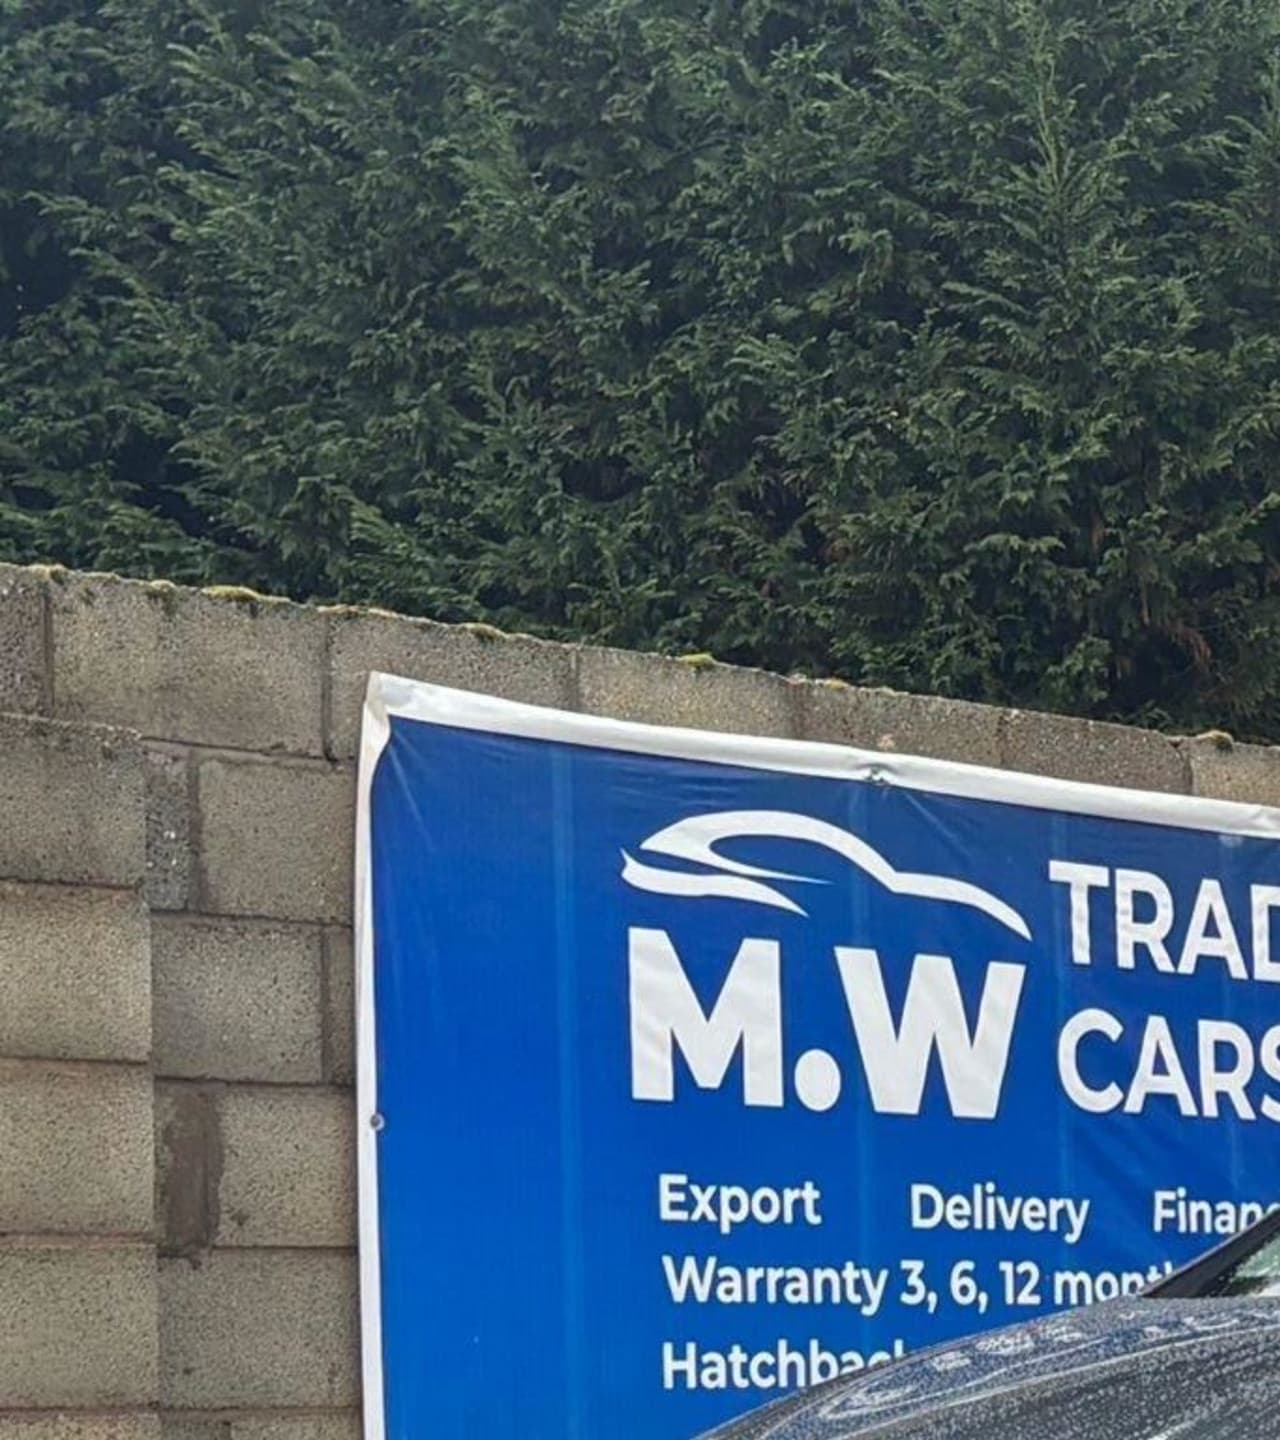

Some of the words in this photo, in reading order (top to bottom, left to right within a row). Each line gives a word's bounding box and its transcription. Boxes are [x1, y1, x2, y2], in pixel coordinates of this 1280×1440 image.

[628, 926, 1027, 1120] M.W
[659, 1173, 822, 1234] Export
[911, 1182, 1090, 1243] Delivery
[662, 1255, 889, 1316] Warranty
[900, 1260, 938, 1314] 3,
[950, 1260, 989, 1314] 6,
[999, 1261, 1041, 1305] 12
